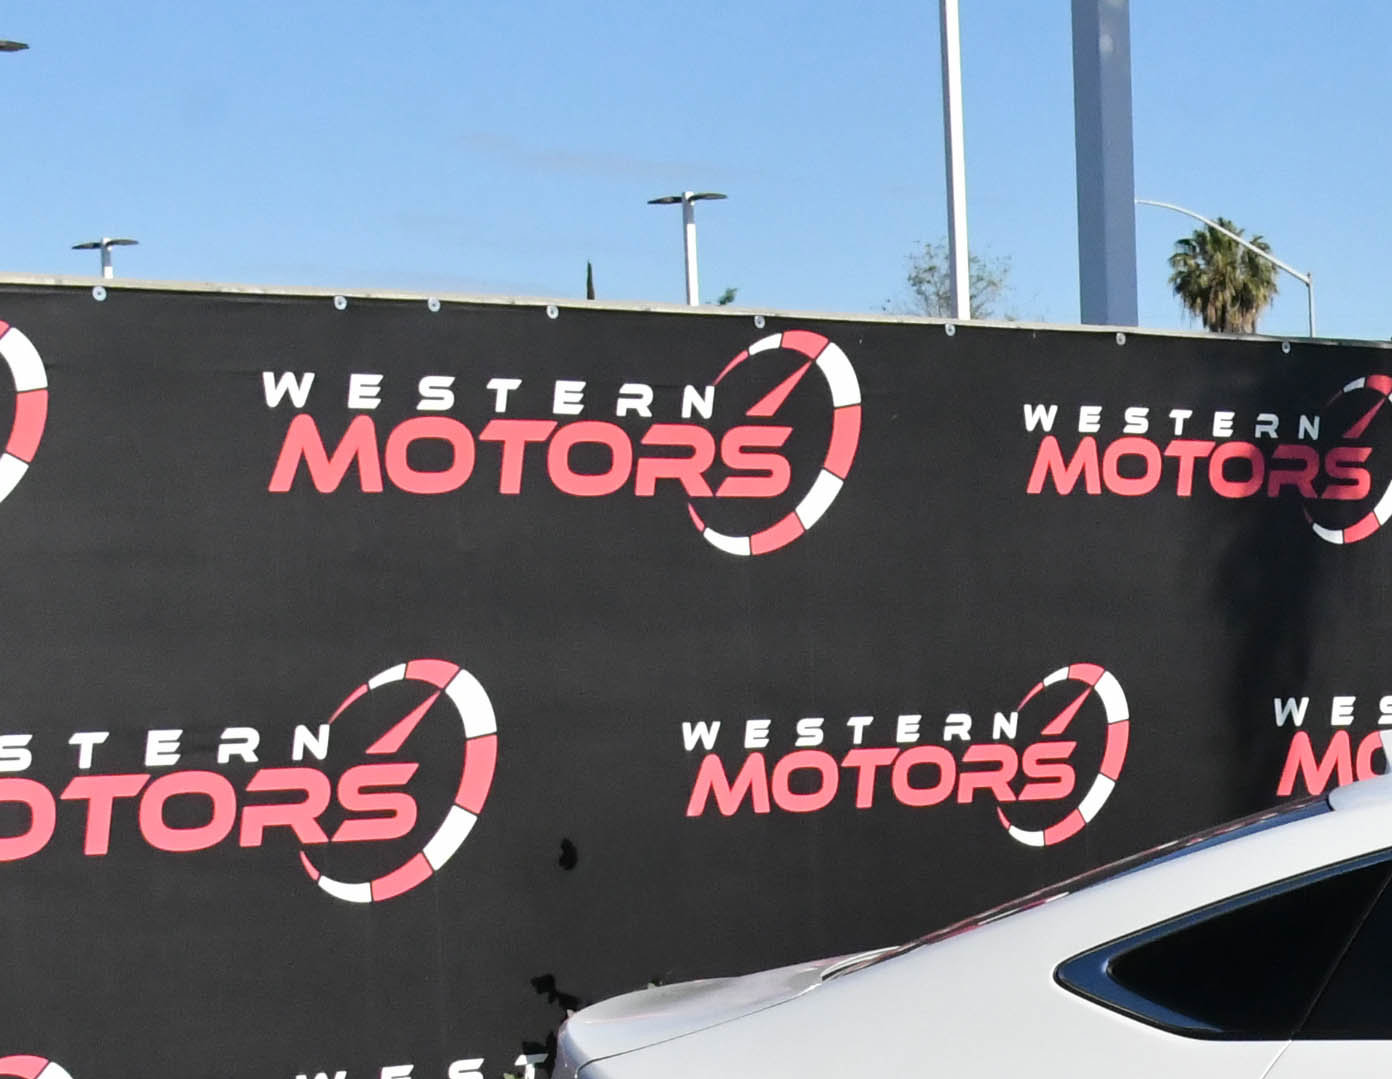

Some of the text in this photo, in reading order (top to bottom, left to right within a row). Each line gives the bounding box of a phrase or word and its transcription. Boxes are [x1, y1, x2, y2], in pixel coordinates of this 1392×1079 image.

[261, 370, 716, 420] WESTERN
[1023, 403, 1320, 441] WESTERN
[266, 412, 794, 499] MOTORS
[1025, 433, 1373, 501] MOTORS
[681, 711, 1019, 752] WESTERN
[685, 739, 1078, 817] MOTORS
